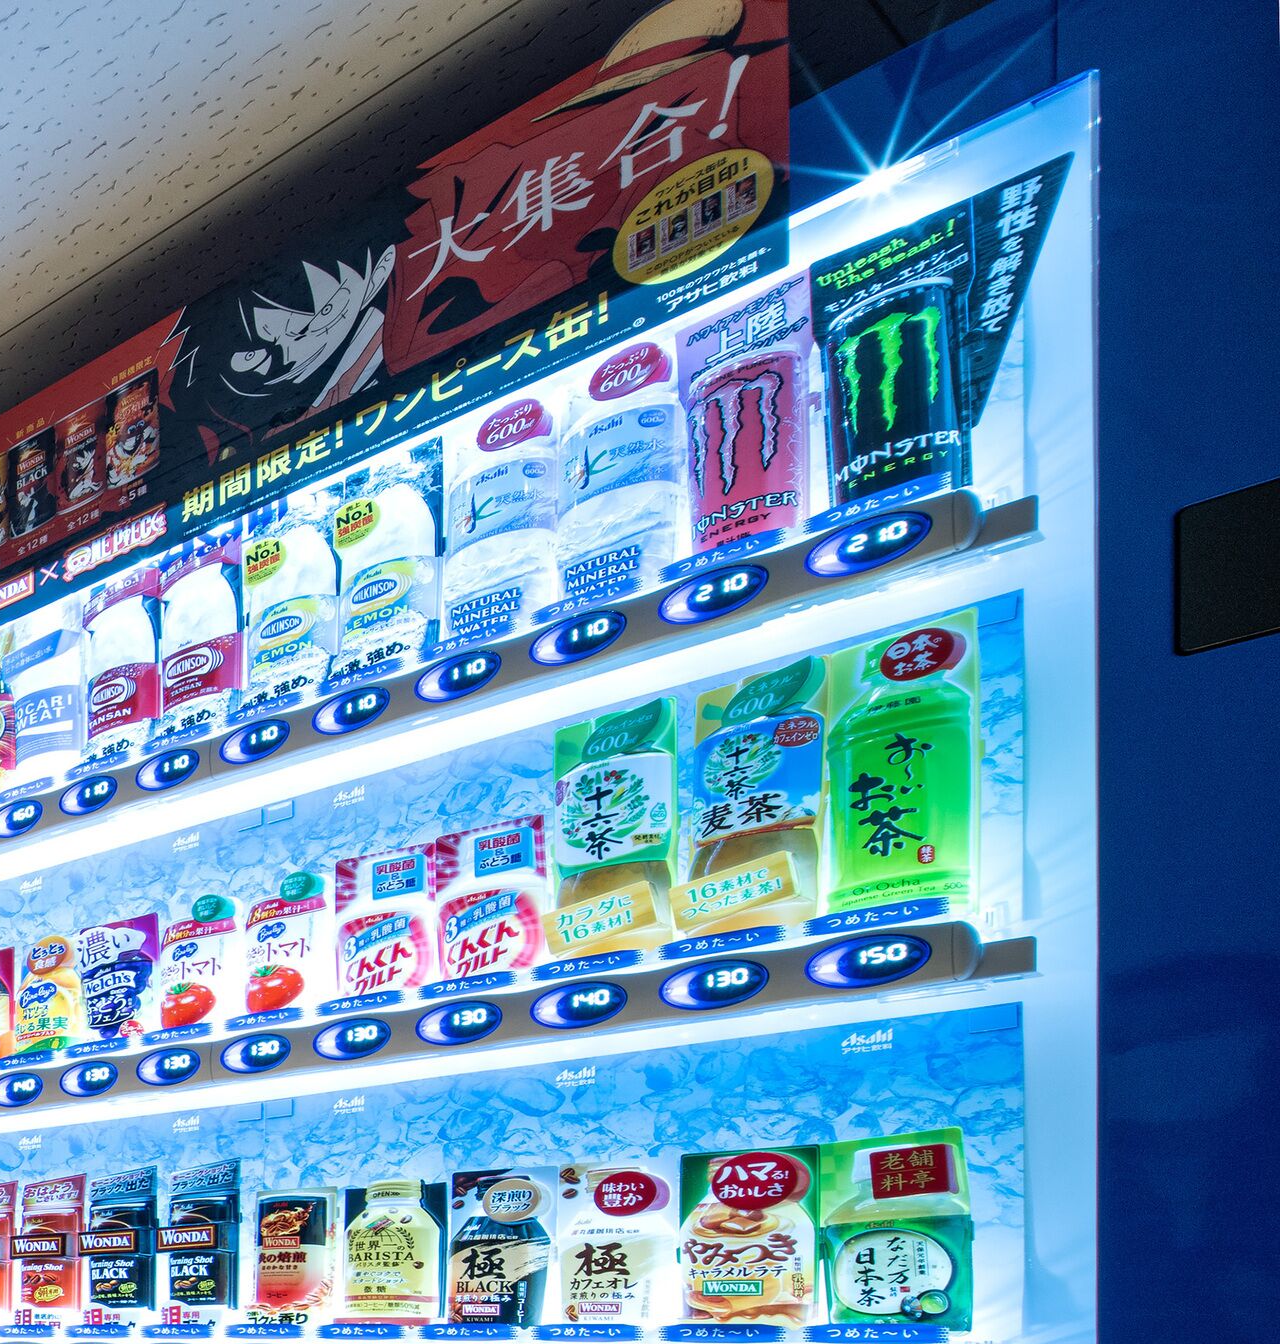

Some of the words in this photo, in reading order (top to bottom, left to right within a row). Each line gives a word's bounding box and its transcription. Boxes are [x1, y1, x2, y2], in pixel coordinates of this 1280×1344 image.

[407, 54, 750, 301] 大集合!
[634, 156, 751, 226] これが目印!
[816, 236, 909, 288] Unleash
[979, 174, 1044, 334] 野性を解き放て
[666, 262, 760, 312] アサヒ飲料
[824, 242, 965, 315] モンスターエナジー
[704, 298, 787, 365] 上陸
[600, 345, 651, 378] たっぷり
[181, 421, 344, 522] 期間限定!
[354, 290, 609, 436] ワンピース缶!
[486, 402, 534, 431] たっぷり
[588, 414, 624, 440] Asahi
[834, 429, 962, 486] MONSTER
[847, 448, 950, 490] ENERGY
[15, 466, 49, 491] BLACK
[474, 466, 510, 487] Asahi
[65, 508, 102, 532] 全12種
[336, 501, 375, 528] No.1
[700, 511, 772, 544] ENERGY
[844, 518, 910, 554] 210
[246, 540, 282, 566] No.1
[566, 545, 641, 579] NATURAL
[567, 558, 640, 591] MINERAL
[694, 571, 750, 603] 210
[351, 578, 398, 607] WILKINSON
[450, 587, 522, 618] NATURAL
[259, 615, 303, 640] WILKINSON
[343, 604, 410, 636] LEMON
[452, 600, 521, 629] MINERAL
[569, 617, 611, 643] 110
[253, 639, 315, 665] LEMON
[893, 650, 938, 677] お茶
[167, 654, 208, 680] WILKINSON
[452, 656, 487, 681] 110
[345, 692, 378, 715] 110
[249, 725, 279, 746] 110
[721, 746, 756, 801] 十六茶
[580, 785, 624, 861] 十六茶
[700, 792, 785, 839] 麦茶
[848, 772, 928, 858] お茶
[477, 832, 522, 852] 乳酸菌
[375, 858, 416, 876] 乳酸菌
[686, 867, 769, 904] 16素材で
[556, 893, 633, 931] カラダに
[681, 879, 783, 921] つくった麦茶!
[560, 909, 633, 944] 16素材!
[76, 930, 131, 969] 濃い
[859, 942, 908, 967] 150
[706, 965, 751, 990] 130
[570, 986, 612, 1009] 140
[452, 1007, 488, 1027] 130
[346, 1023, 379, 1043] 130
[840, 1028, 895, 1048] Asahi
[251, 1039, 281, 1057] 130
[840, 1042, 894, 1055] アサヒ飲料
[555, 1065, 597, 1082] Asahi
[716, 1160, 790, 1185] ハマる!
[879, 1149, 936, 1172] 老舗
[601, 1181, 646, 1193] 味わい
[718, 1181, 785, 1200] おいしさ
[880, 1170, 937, 1192] 料亭
[602, 1192, 644, 1208] 豊か
[13, 1237, 58, 1253] WONDA
[79, 1233, 131, 1250] WONDA
[159, 1229, 210, 1245] WONDA
[263, 1237, 298, 1249] WONDA
[682, 1232, 798, 1267] やみつき
[348, 1251, 416, 1263] BARISTA
[459, 1247, 507, 1281] 極
[573, 1241, 632, 1276] 極
[91, 1267, 129, 1281] BLACK
[170, 1264, 209, 1278] BLACK
[569, 1277, 639, 1291] カフェオレ
[687, 1264, 788, 1280] キャラメルラテ
[853, 1247, 887, 1307] 日本茶
[455, 1279, 514, 1294] BLACK
[706, 1281, 758, 1294] WONDA
[463, 1304, 497, 1314] WONDA
[580, 1302, 621, 1314] WONDA
